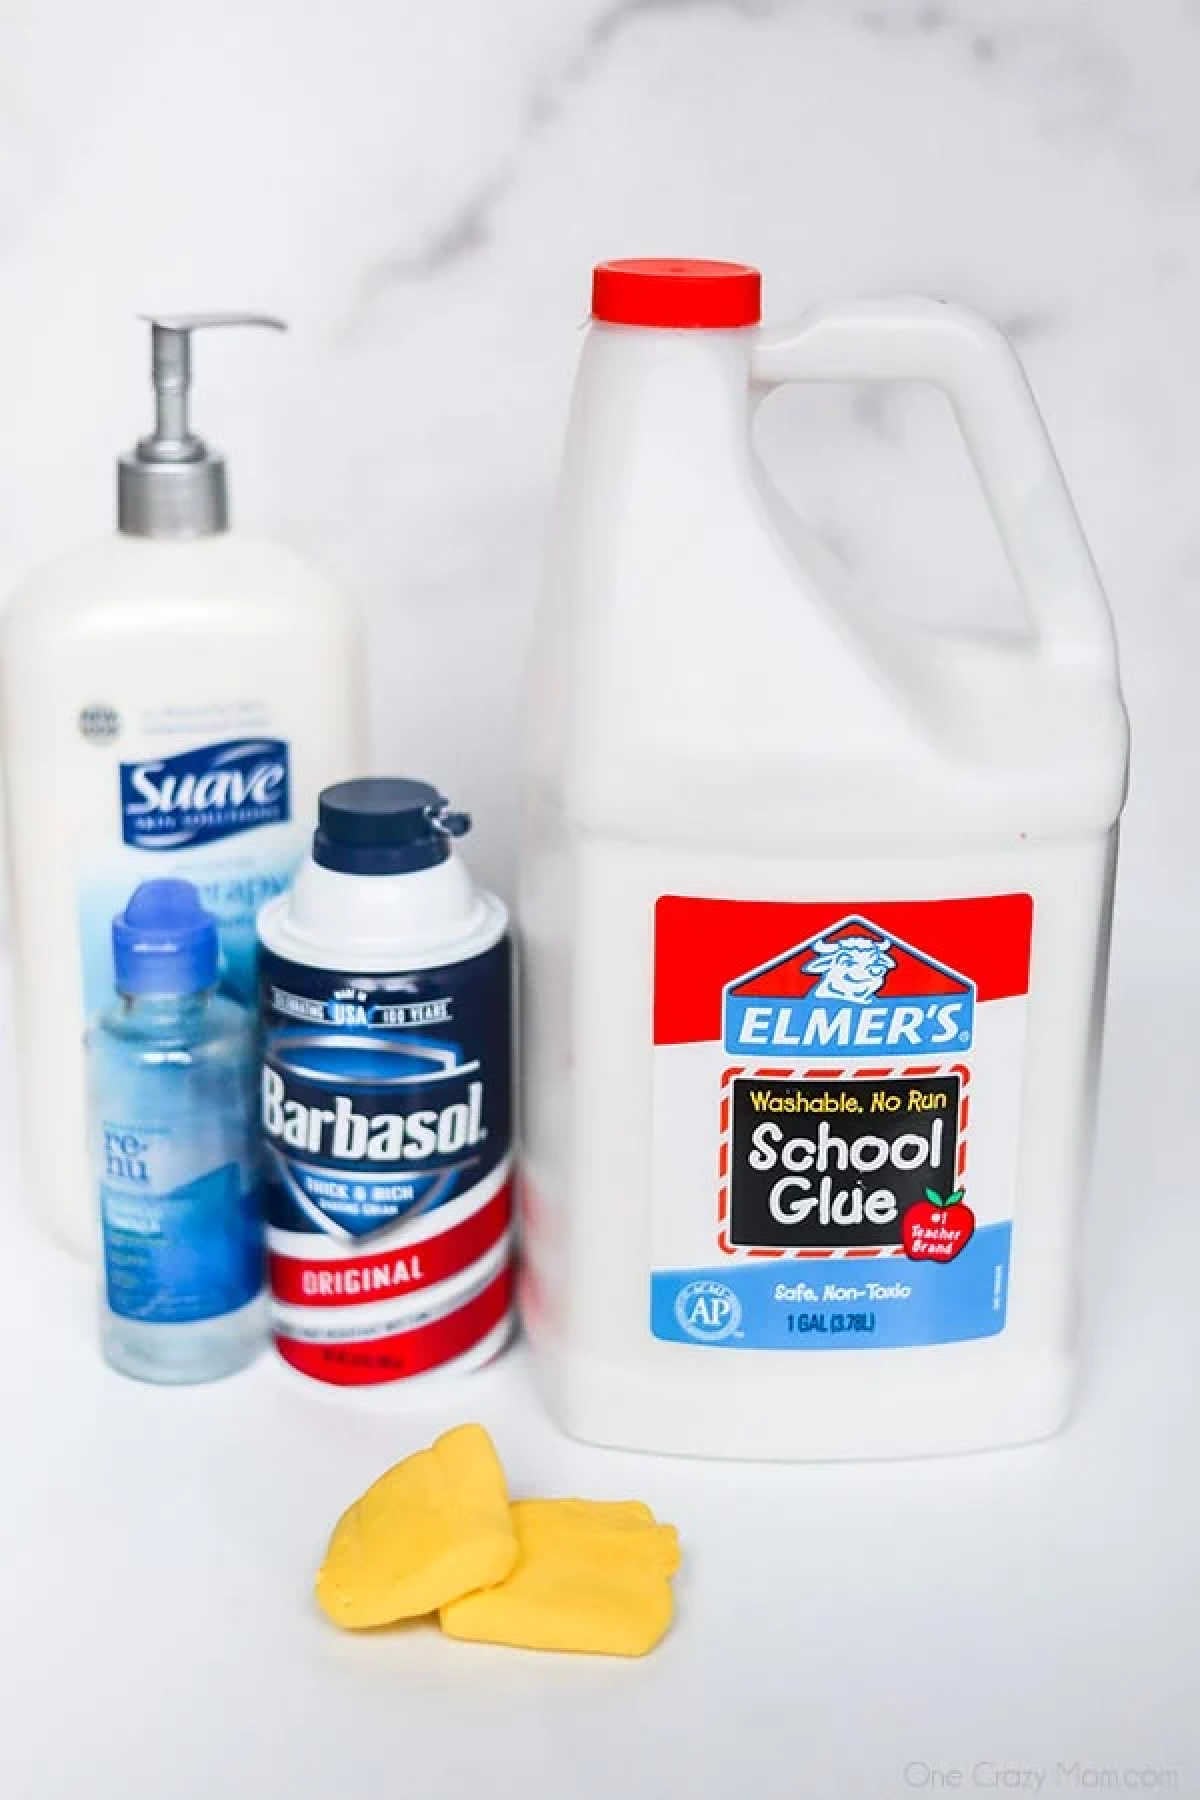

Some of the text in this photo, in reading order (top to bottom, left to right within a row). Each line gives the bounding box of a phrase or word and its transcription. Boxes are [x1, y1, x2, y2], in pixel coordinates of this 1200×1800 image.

[127, 763, 285, 813] Suave
[337, 1004, 367, 1026] USA
[739, 1005, 961, 1046] ELMER'S
[261, 1064, 483, 1160] Barbasol
[870, 1090, 901, 1112] No
[908, 1089, 947, 1111] Run
[748, 1119, 944, 1172] School
[769, 1175, 899, 1226] Glue
[911, 1224, 961, 1240] Teacher
[912, 1239, 953, 1254] Brand
[302, 1256, 424, 1297] ORIGINAL
[688, 1296, 730, 1325] AP
[798, 1313, 829, 1332] GAL
